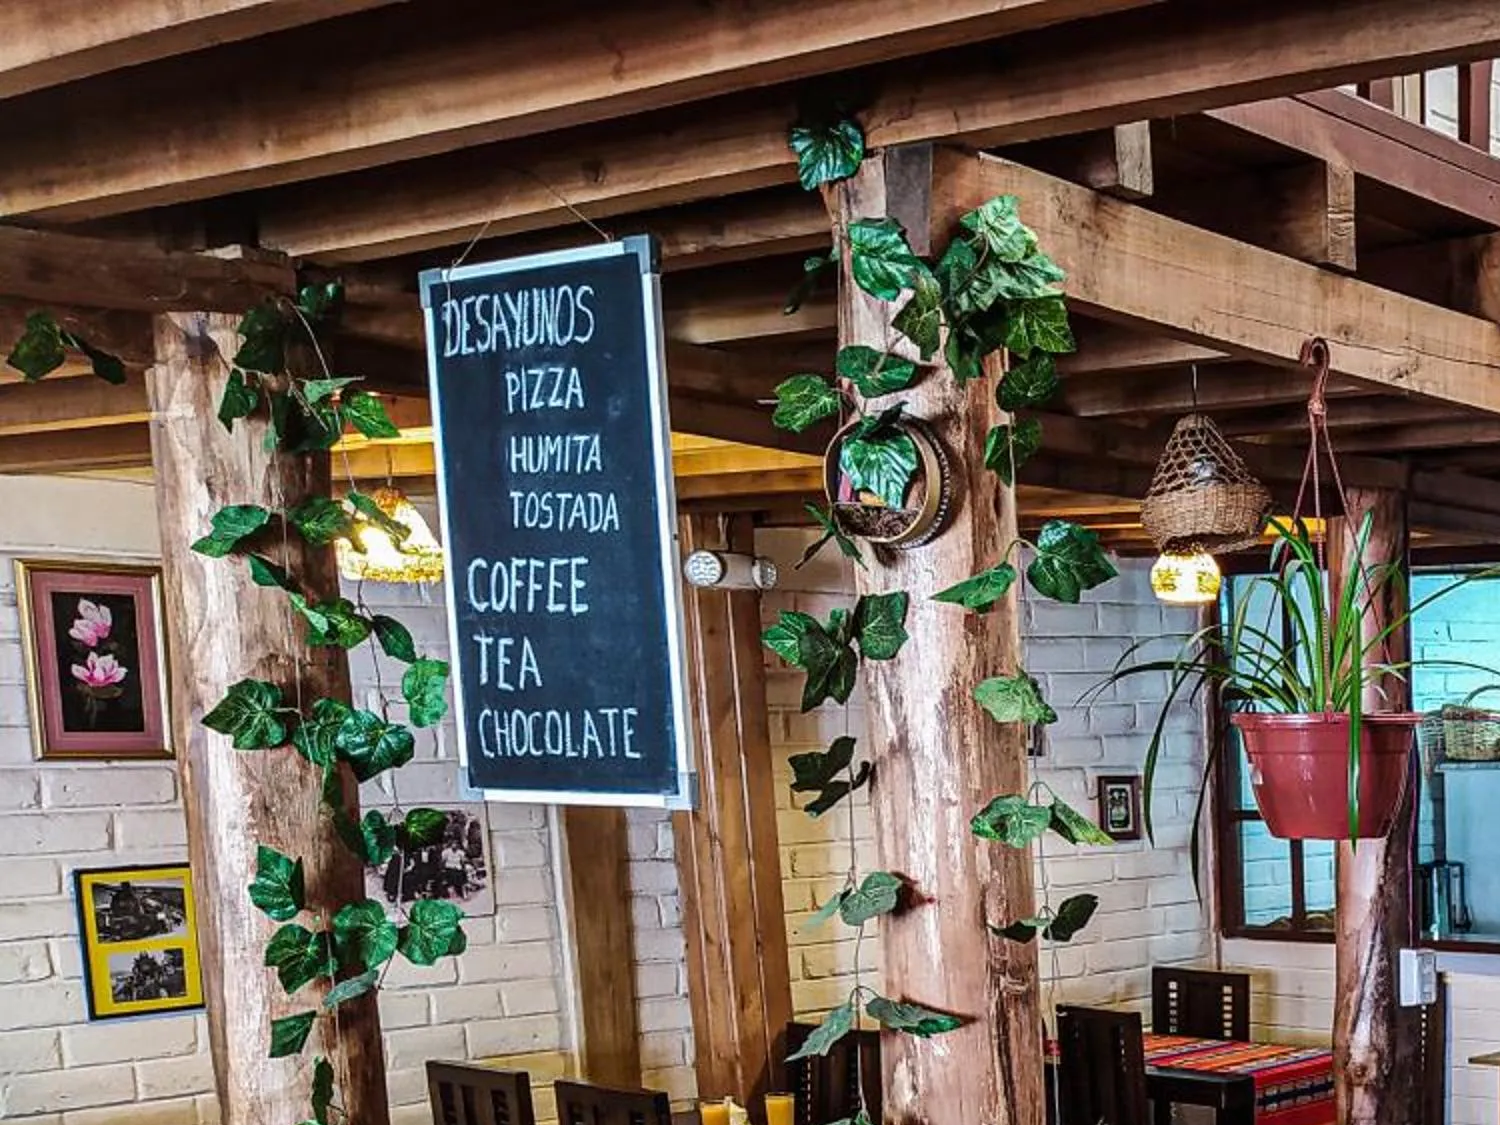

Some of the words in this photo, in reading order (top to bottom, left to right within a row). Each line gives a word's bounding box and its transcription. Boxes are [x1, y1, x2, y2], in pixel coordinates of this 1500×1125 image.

[442, 285, 595, 357] DESAYUNOS
[505, 366, 584, 414] PIZZA
[509, 434, 602, 474] HUMITA
[509, 490, 620, 533] TOSTADA
[467, 556, 589, 616] COFFEE
[472, 631, 543, 691] TEA
[478, 707, 641, 758] CHOCOLATE
